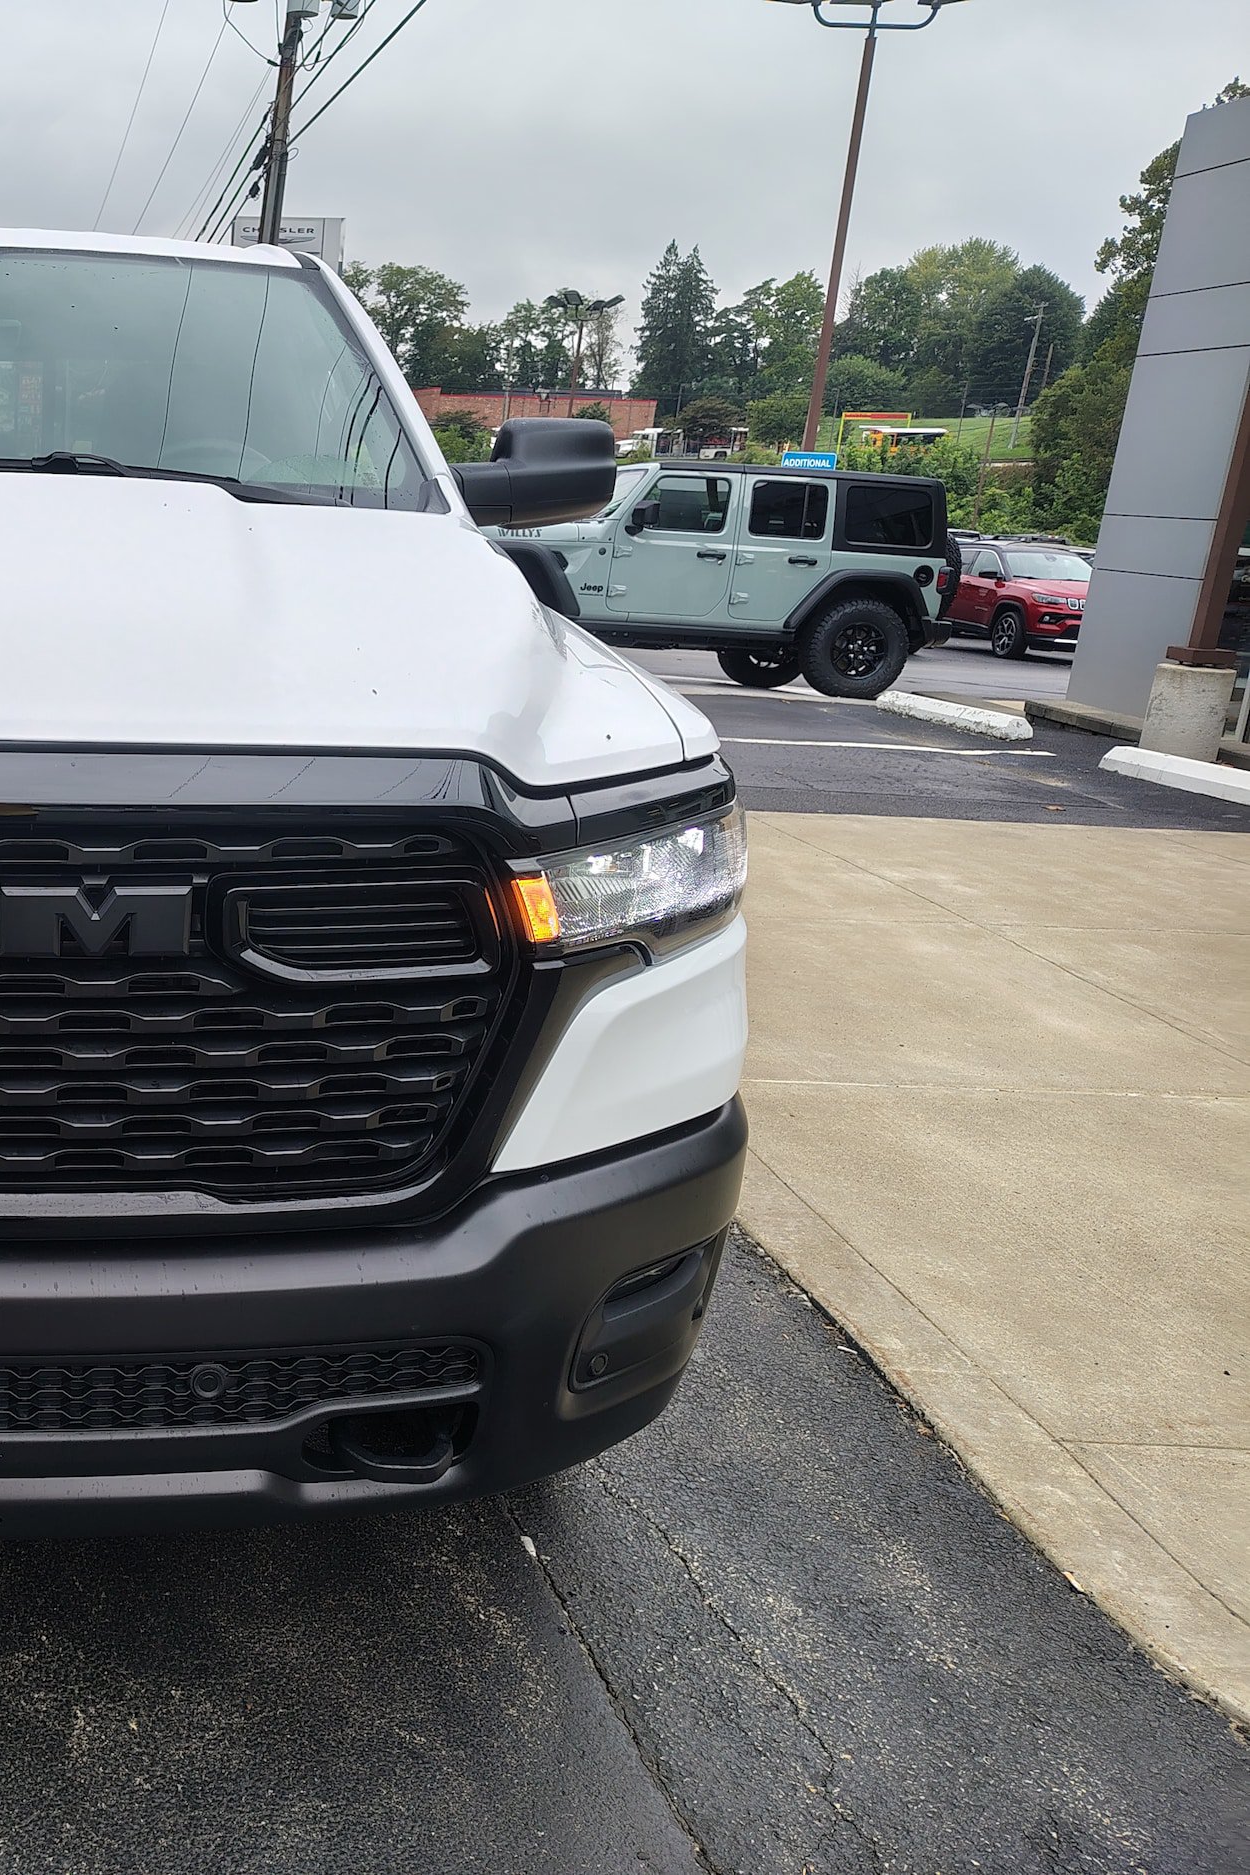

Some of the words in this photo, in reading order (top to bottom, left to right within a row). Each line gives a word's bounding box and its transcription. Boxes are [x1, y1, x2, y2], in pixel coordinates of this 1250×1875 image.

[242, 226, 315, 234] CHSLER
[783, 458, 831, 468] ADDITIONAL
[497, 528, 542, 538] WILLYS
[580, 582, 604, 593] Jeep
